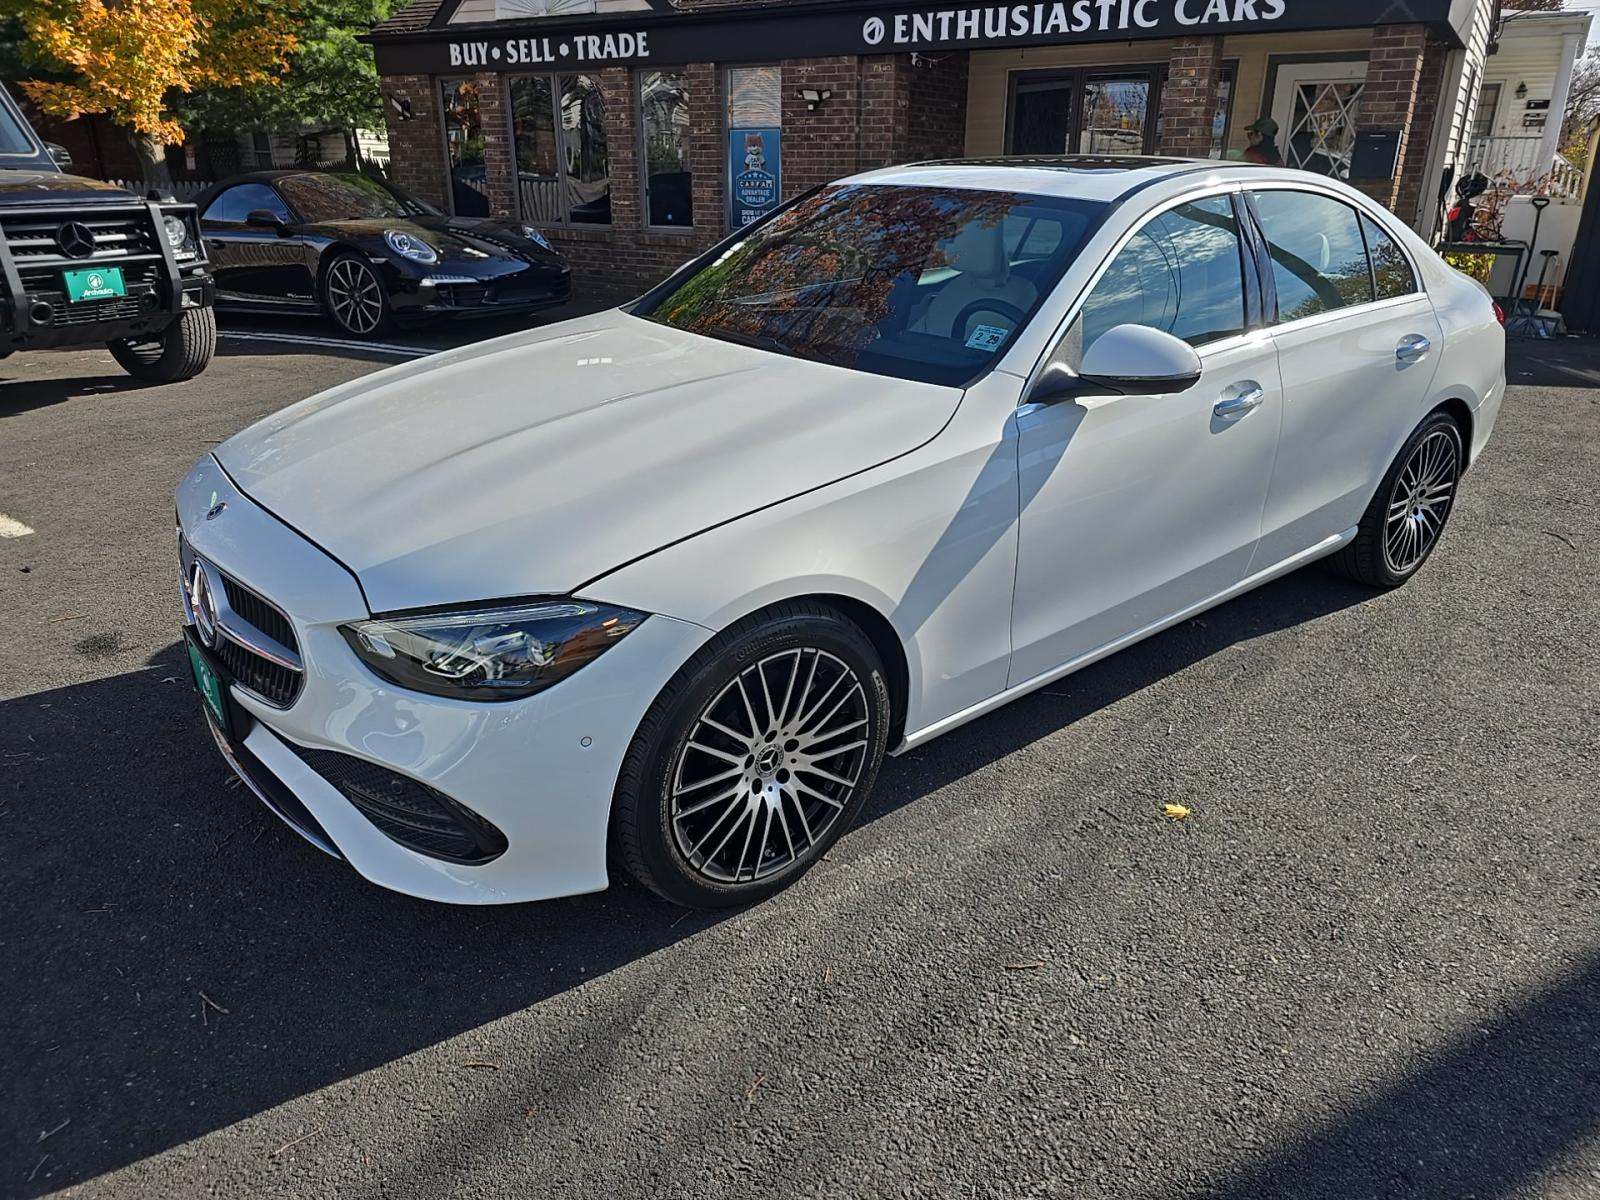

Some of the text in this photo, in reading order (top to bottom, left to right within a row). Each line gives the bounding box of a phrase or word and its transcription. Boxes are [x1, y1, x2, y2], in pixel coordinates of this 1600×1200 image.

[894, 0, 1286, 44] ENTHUSIASTIC CARS
[450, 32, 650, 66] BUY SELL TRADE
[746, 195, 766, 203] DEALER
[975, 332, 984, 340] 2
